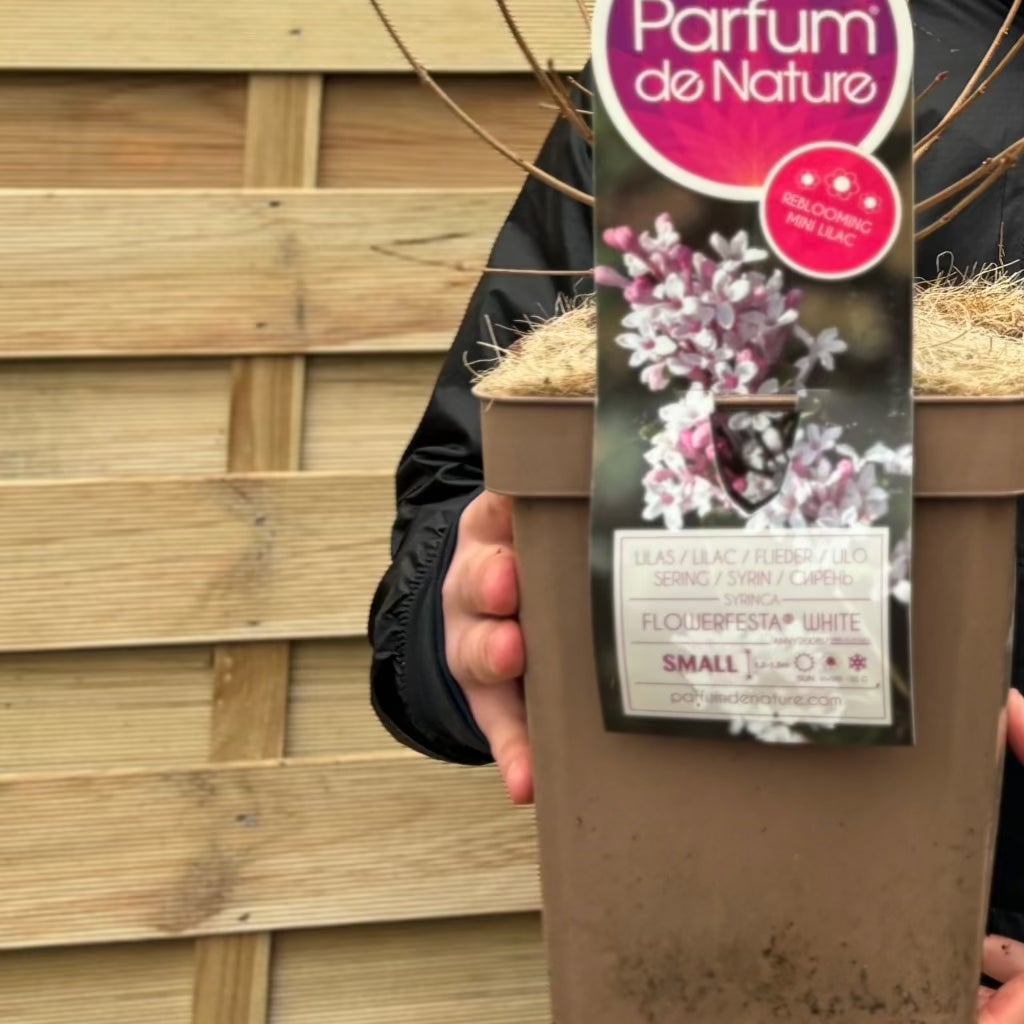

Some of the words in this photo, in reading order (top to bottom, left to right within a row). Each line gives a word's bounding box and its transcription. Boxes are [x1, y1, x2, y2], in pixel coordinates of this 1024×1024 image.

[634, 59, 705, 103] de
[712, 59, 877, 105] Nature
[785, 211, 817, 232] MINI
[817, 221, 858, 248] LILAC
[634, 548, 675, 565] LILAS
[692, 548, 737, 565] LILAC
[754, 547, 813, 565] FLIEDER
[832, 547, 869, 565] LILO
[653, 570, 710, 587] SERING
[726, 570, 771, 586] SYRIN
[802, 612, 861, 632] WHITE
[662, 653, 738, 673] SMALL
